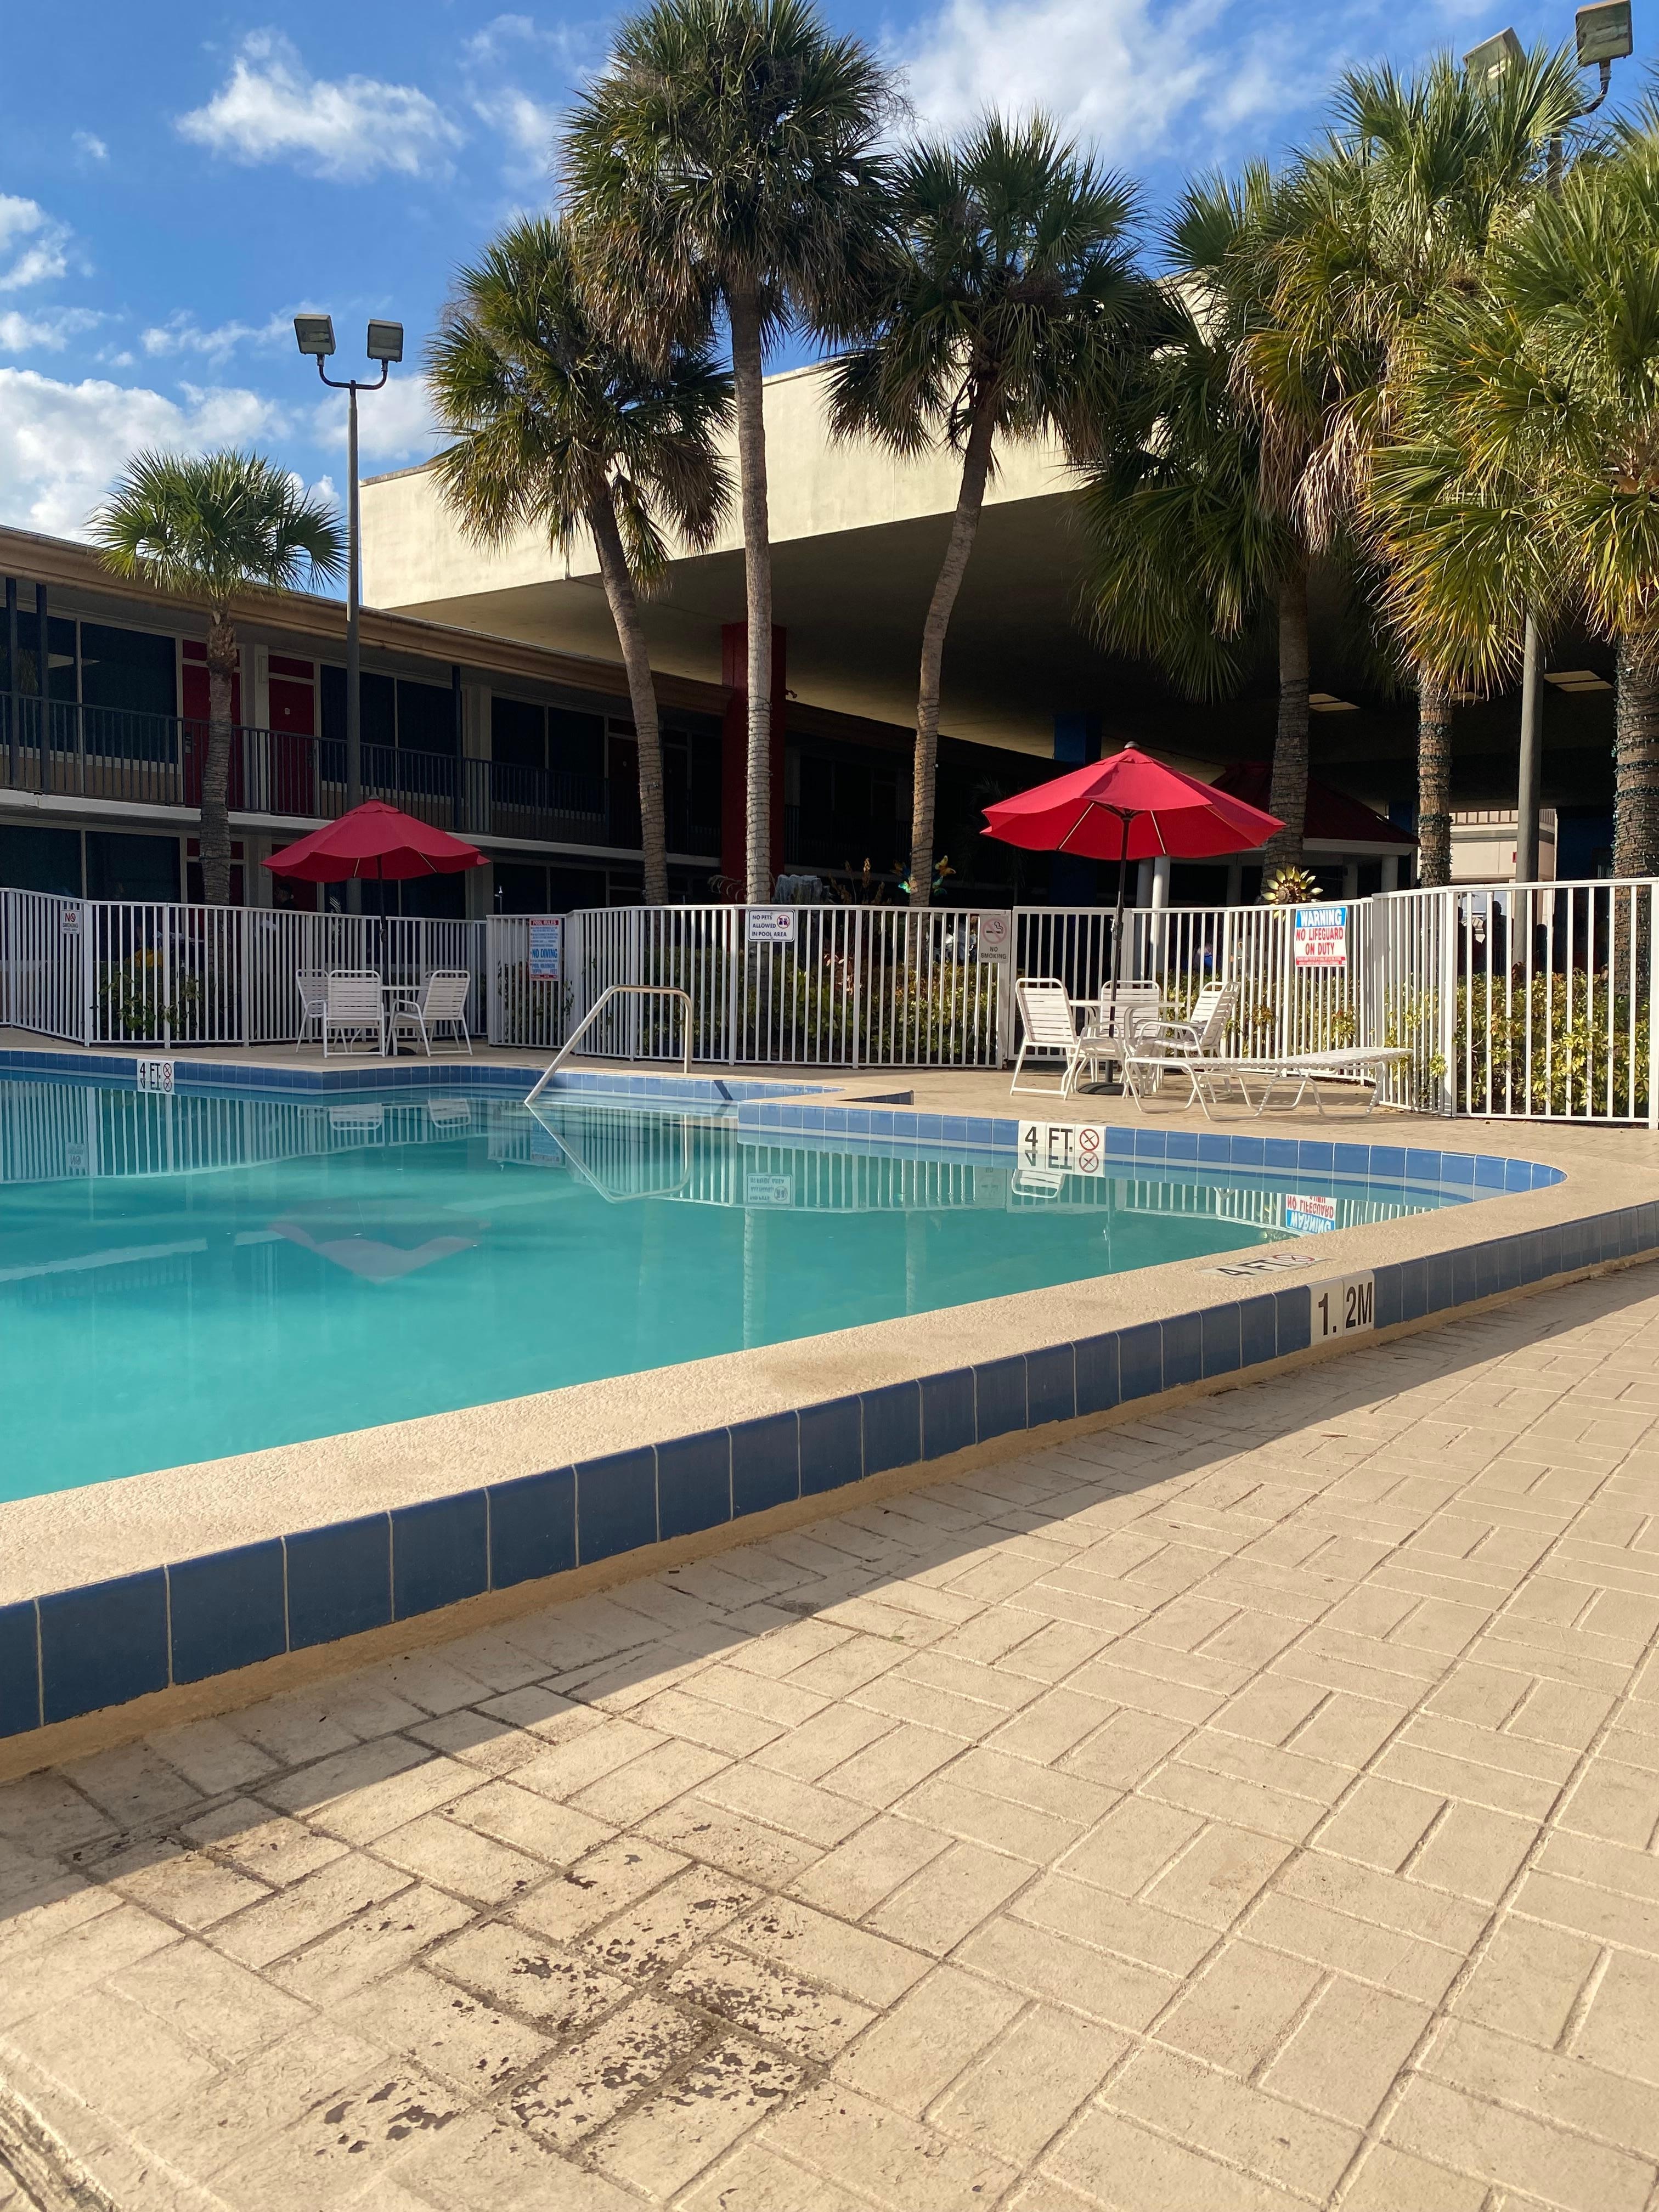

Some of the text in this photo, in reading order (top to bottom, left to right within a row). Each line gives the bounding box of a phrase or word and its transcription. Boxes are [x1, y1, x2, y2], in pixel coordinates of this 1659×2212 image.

[65, 912, 76, 922] NO
[1300, 909, 1342, 927] WARNING
[1296, 927, 1343, 941] NO LIFEGUARD
[532, 949, 558, 958] NO DIVING
[1306, 943, 1335, 955] ON DUTY
[140, 1063, 146, 1077] 4
[1025, 1126, 1038, 1147] 4
